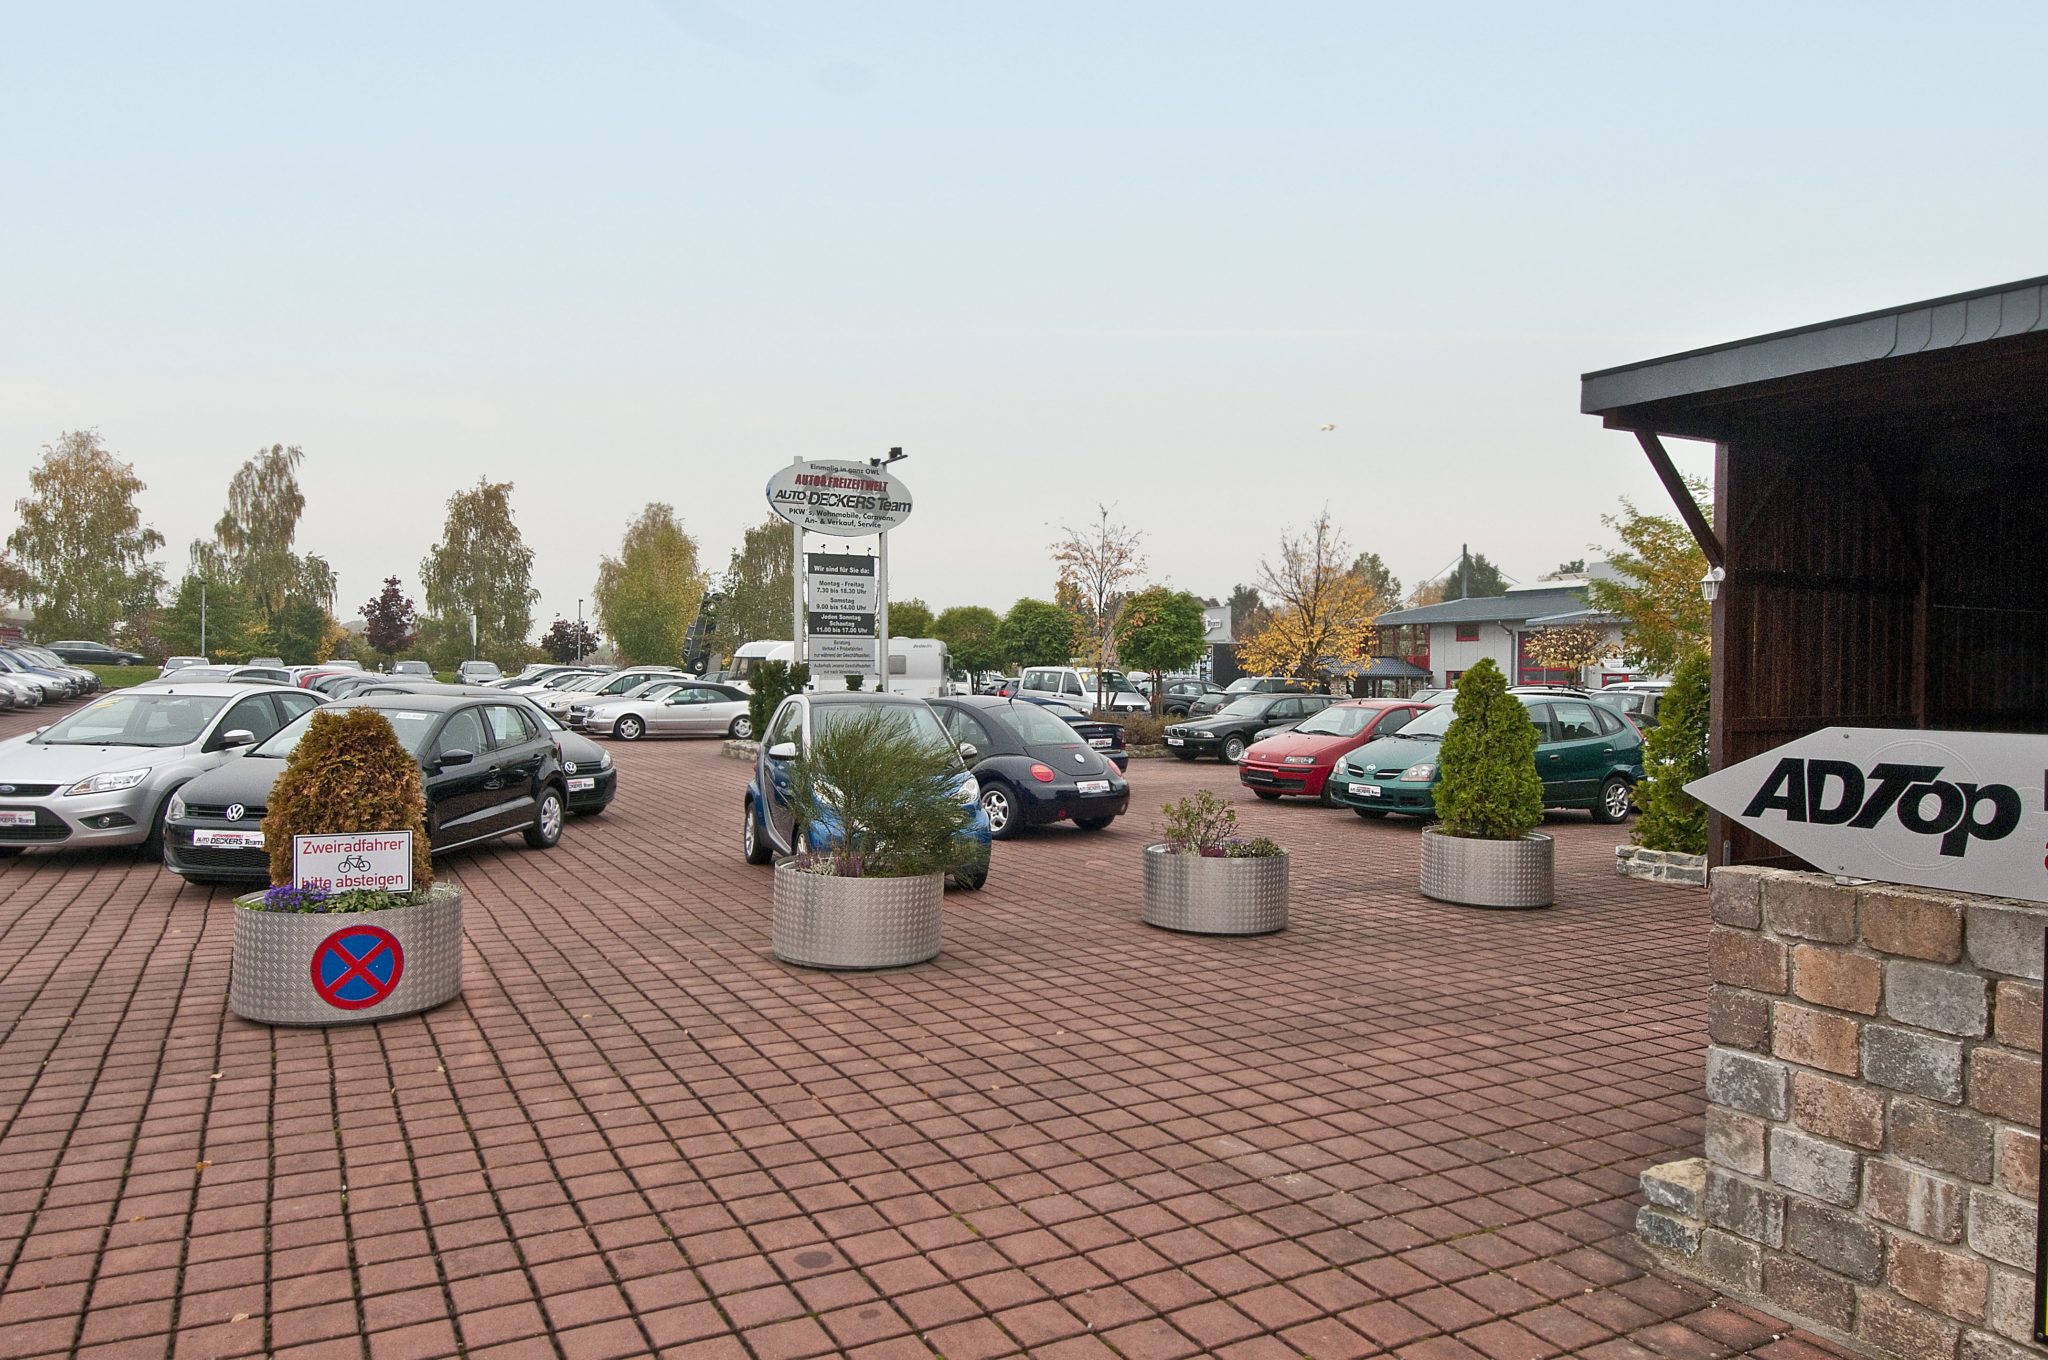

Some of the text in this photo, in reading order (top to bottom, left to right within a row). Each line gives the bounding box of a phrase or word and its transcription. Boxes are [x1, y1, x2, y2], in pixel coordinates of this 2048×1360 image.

[810, 464, 839, 473] Einmalig
[775, 489, 912, 513] AUTO DECKERS Team
[816, 510, 862, 520] Wohnmobile,
[862, 512, 896, 522] Caravans,
[827, 518, 856, 528] Verkauf,
[858, 520, 882, 528] Service
[302, 838, 404, 854] Zweiradfahrer
[302, 873, 404, 890] bitte absteigen
